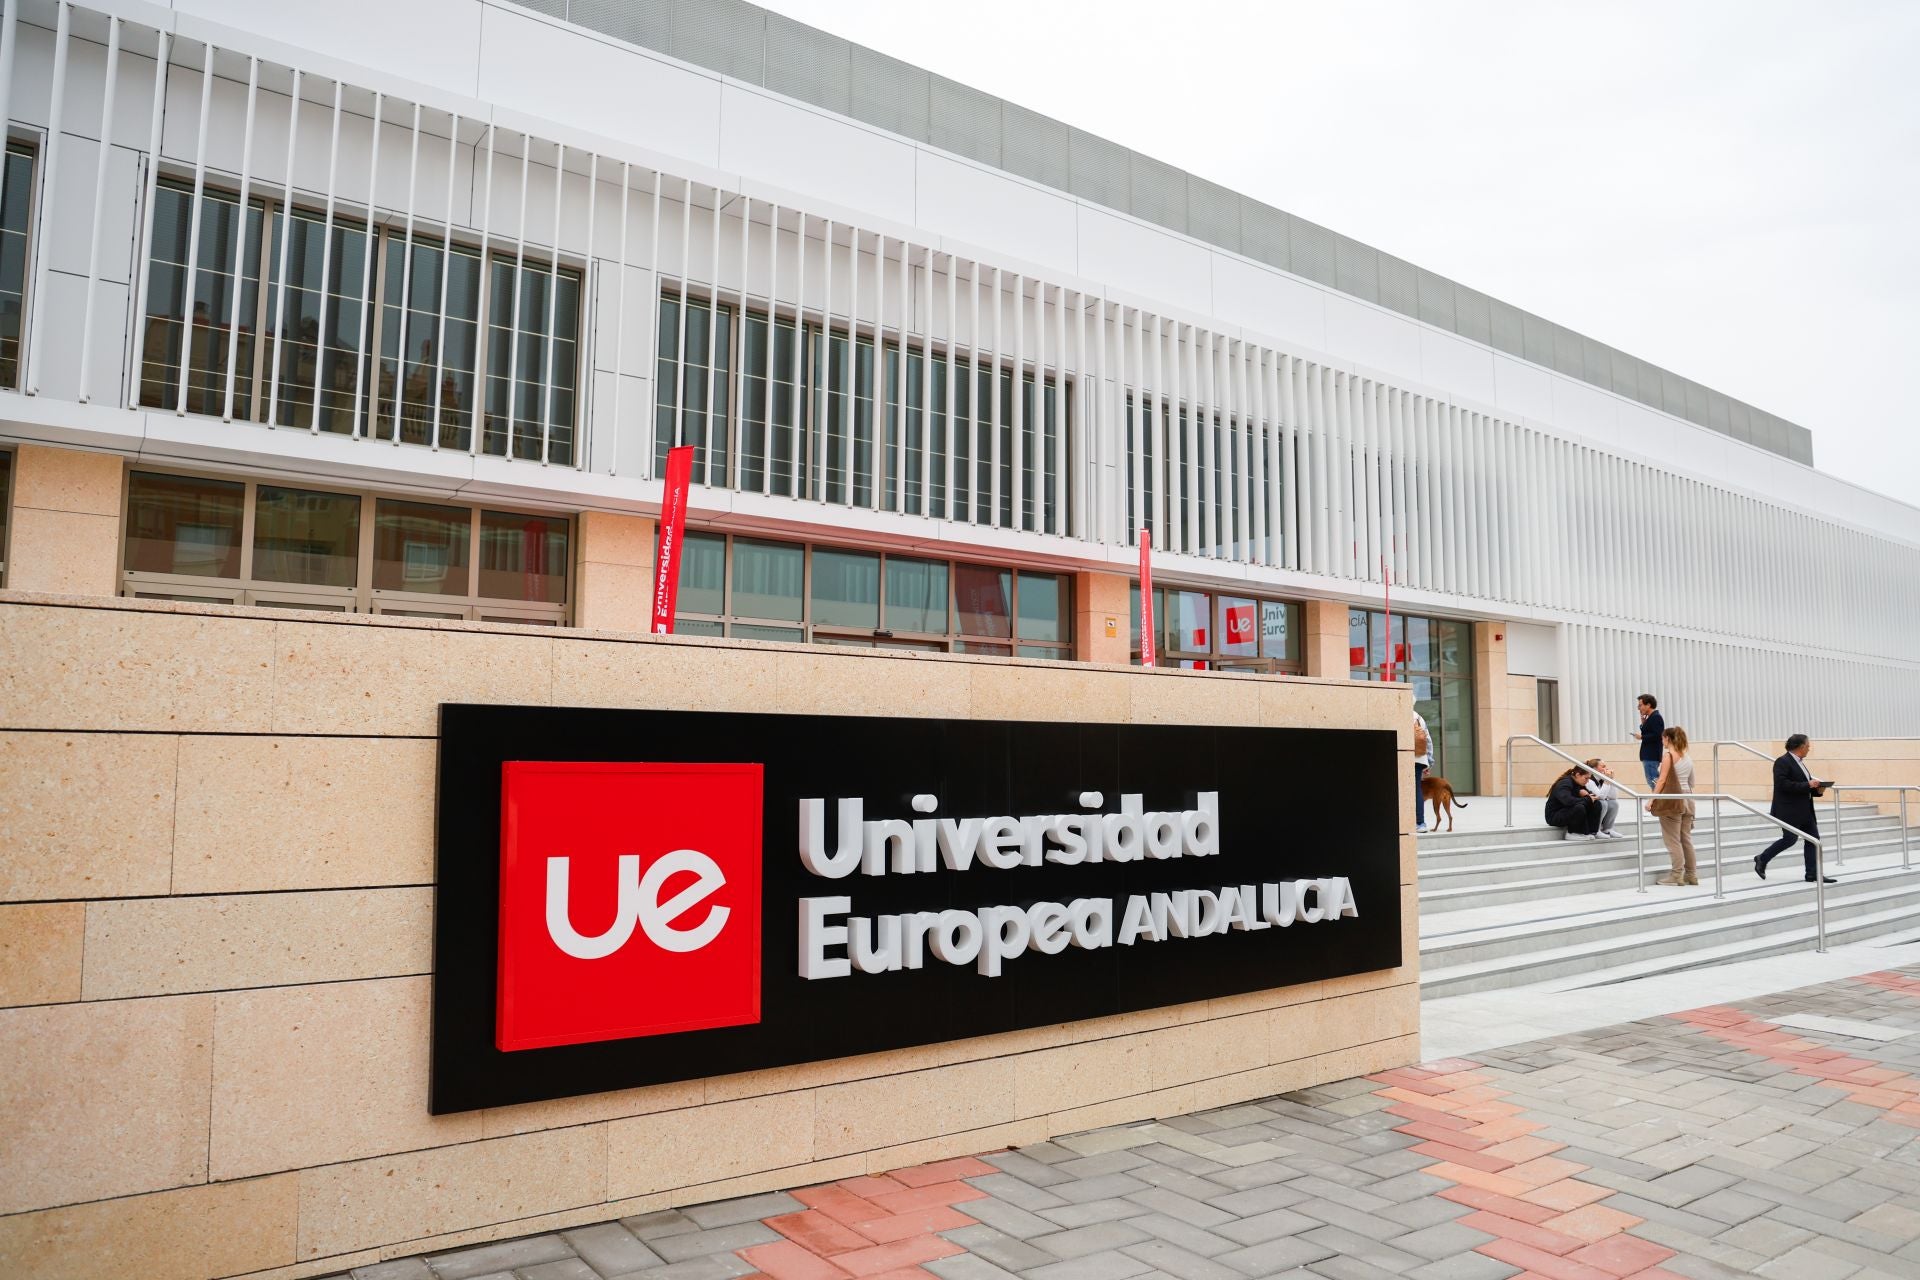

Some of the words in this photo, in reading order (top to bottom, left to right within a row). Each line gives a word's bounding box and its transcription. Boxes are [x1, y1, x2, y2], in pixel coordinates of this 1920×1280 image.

[1230, 617, 1252, 634] ue
[799, 791, 1220, 879] Universidad
[546, 850, 731, 960] ue
[799, 896, 1113, 980] Europea
